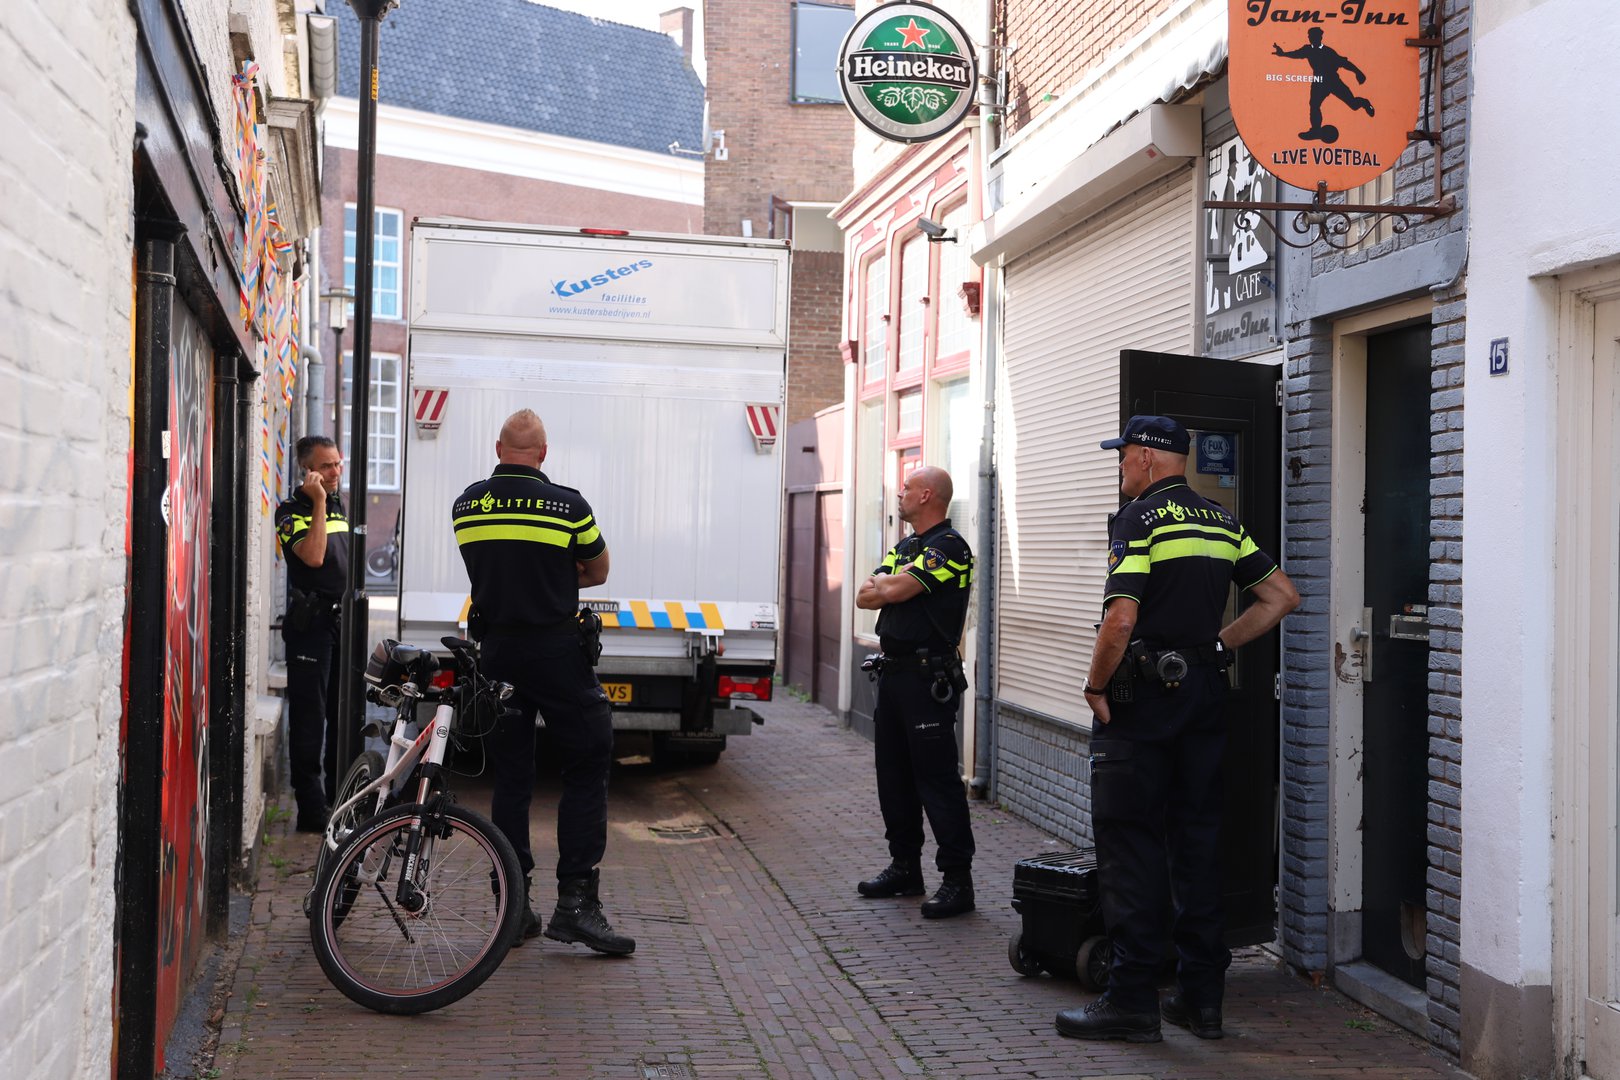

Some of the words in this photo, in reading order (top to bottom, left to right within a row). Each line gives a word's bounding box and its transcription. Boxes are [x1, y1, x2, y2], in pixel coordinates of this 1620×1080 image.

[1246, 0, 1409, 27] Jam-Inn
[853, 55, 967, 83] Heineken
[1266, 74, 1283, 82] BIG
[1285, 74, 1323, 83] SCREEN!
[1273, 148, 1307, 165] LIVE
[1312, 147, 1381, 167] VOETBAL
[554, 259, 653, 297] Kusters
[1235, 271, 1262, 301] CAFE
[601, 293, 647, 304] facilities
[549, 306, 652, 319] www.kustersbedrijven.nl
[1205, 311, 1270, 352] Jam-Inn
[1492, 343, 1506, 371] 15
[1208, 440, 1224, 450] FOX
[470, 492, 545, 513] POLITIE
[1156, 500, 1224, 522] POLITIE
[578, 602, 618, 611] OLLANDIA
